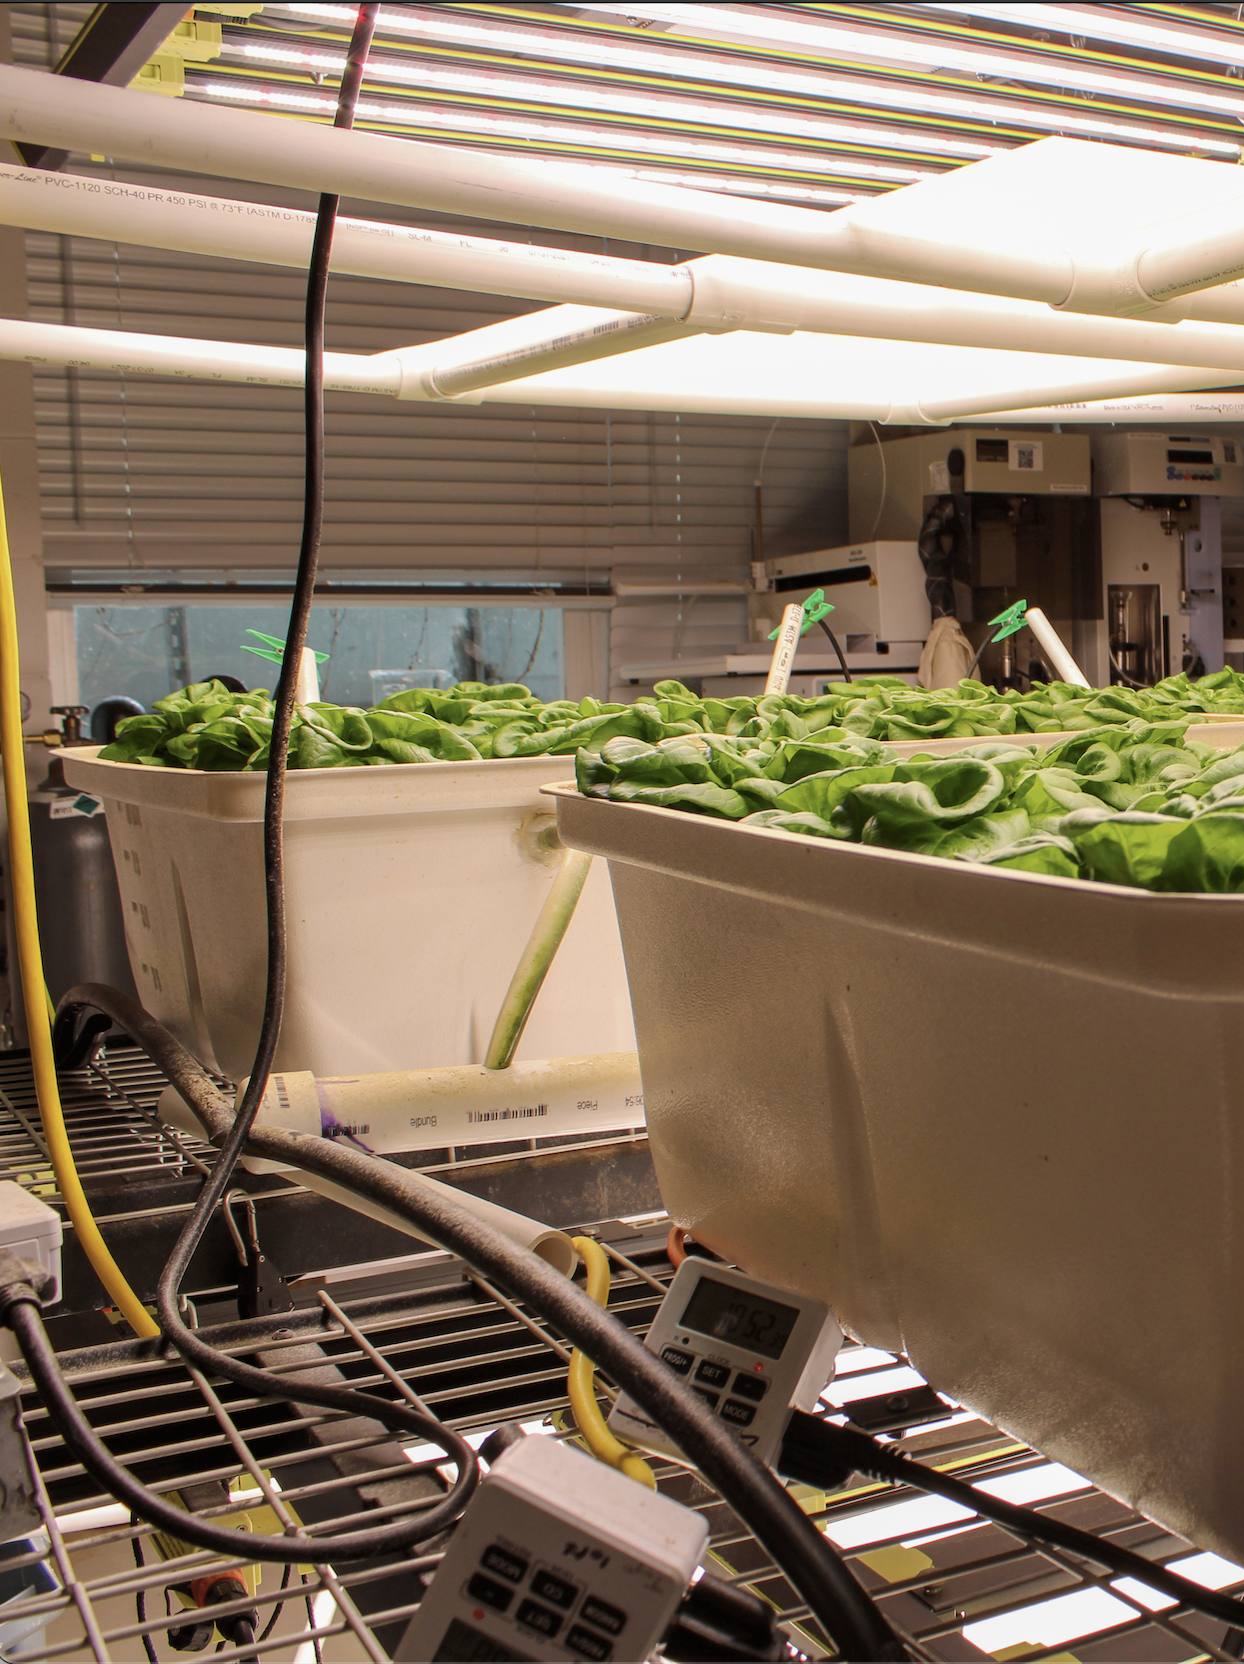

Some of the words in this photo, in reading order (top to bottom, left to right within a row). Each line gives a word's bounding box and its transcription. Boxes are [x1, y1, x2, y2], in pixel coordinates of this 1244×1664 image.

[44, 175, 101, 194] PVC-1120
[103, 184, 146, 201] SCH-40
[147, 191, 164, 203] PR
[166, 194, 186, 207] 450
[187, 197, 208, 210] PSI
[577, 1100, 598, 1112] Piece
[410, 1115, 437, 1129] Bundle
[707, 1352, 731, 1366] CLOCK
[701, 1364, 722, 1379] SET
[722, 1404, 750, 1421] MODE
[486, 1554, 521, 1579] MODE
[525, 1610, 552, 1631] SET
